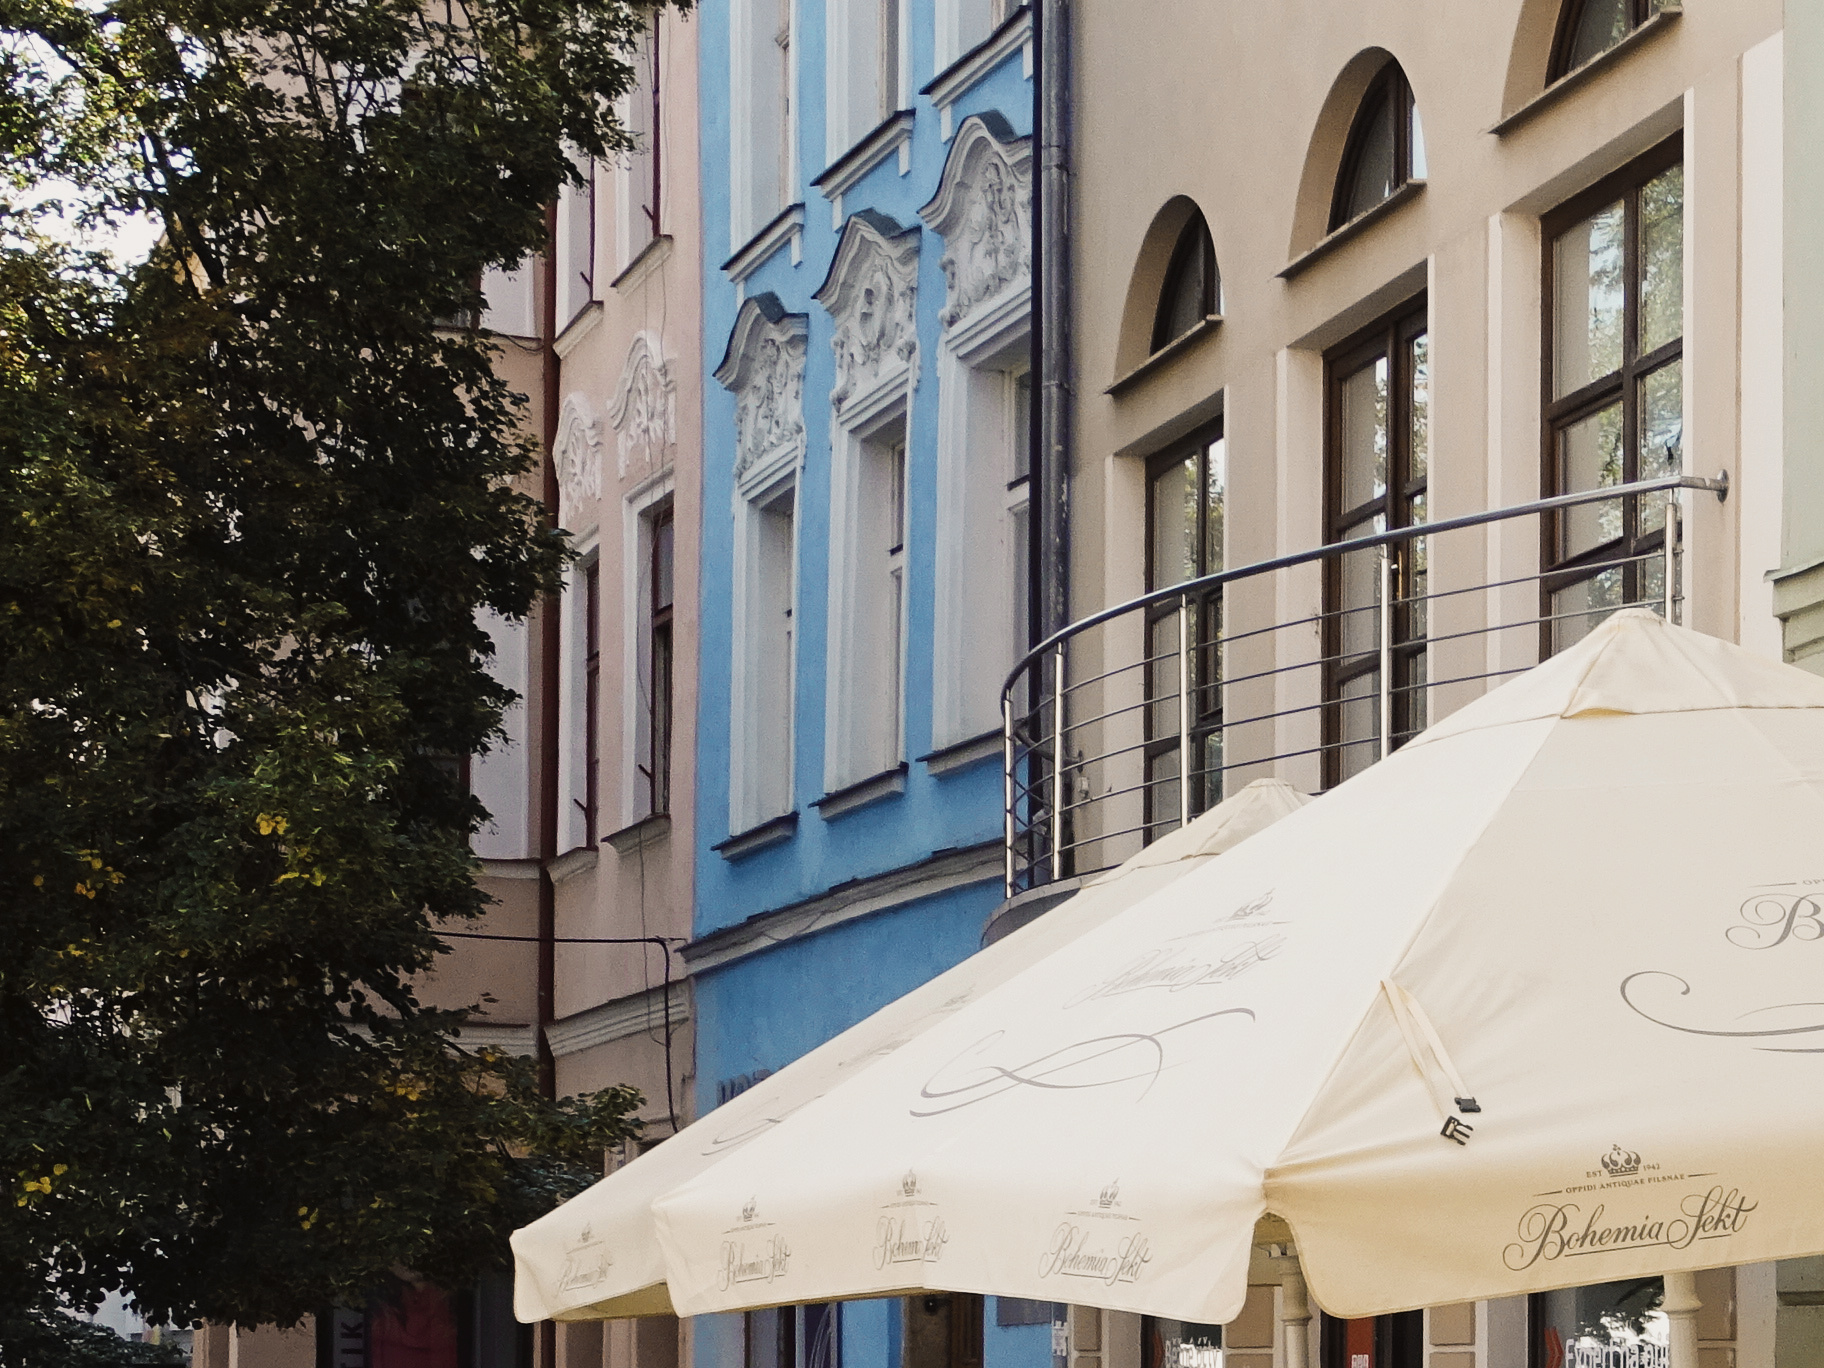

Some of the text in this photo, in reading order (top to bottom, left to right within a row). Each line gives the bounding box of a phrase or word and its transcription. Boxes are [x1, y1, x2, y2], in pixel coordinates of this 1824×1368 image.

[1565, 1173, 1686, 1194] OPPIDI ANTIQUAE PILSNAE
[1586, 1170, 1603, 1178] EST
[1502, 1185, 1759, 1271] Bohemia Sekt
